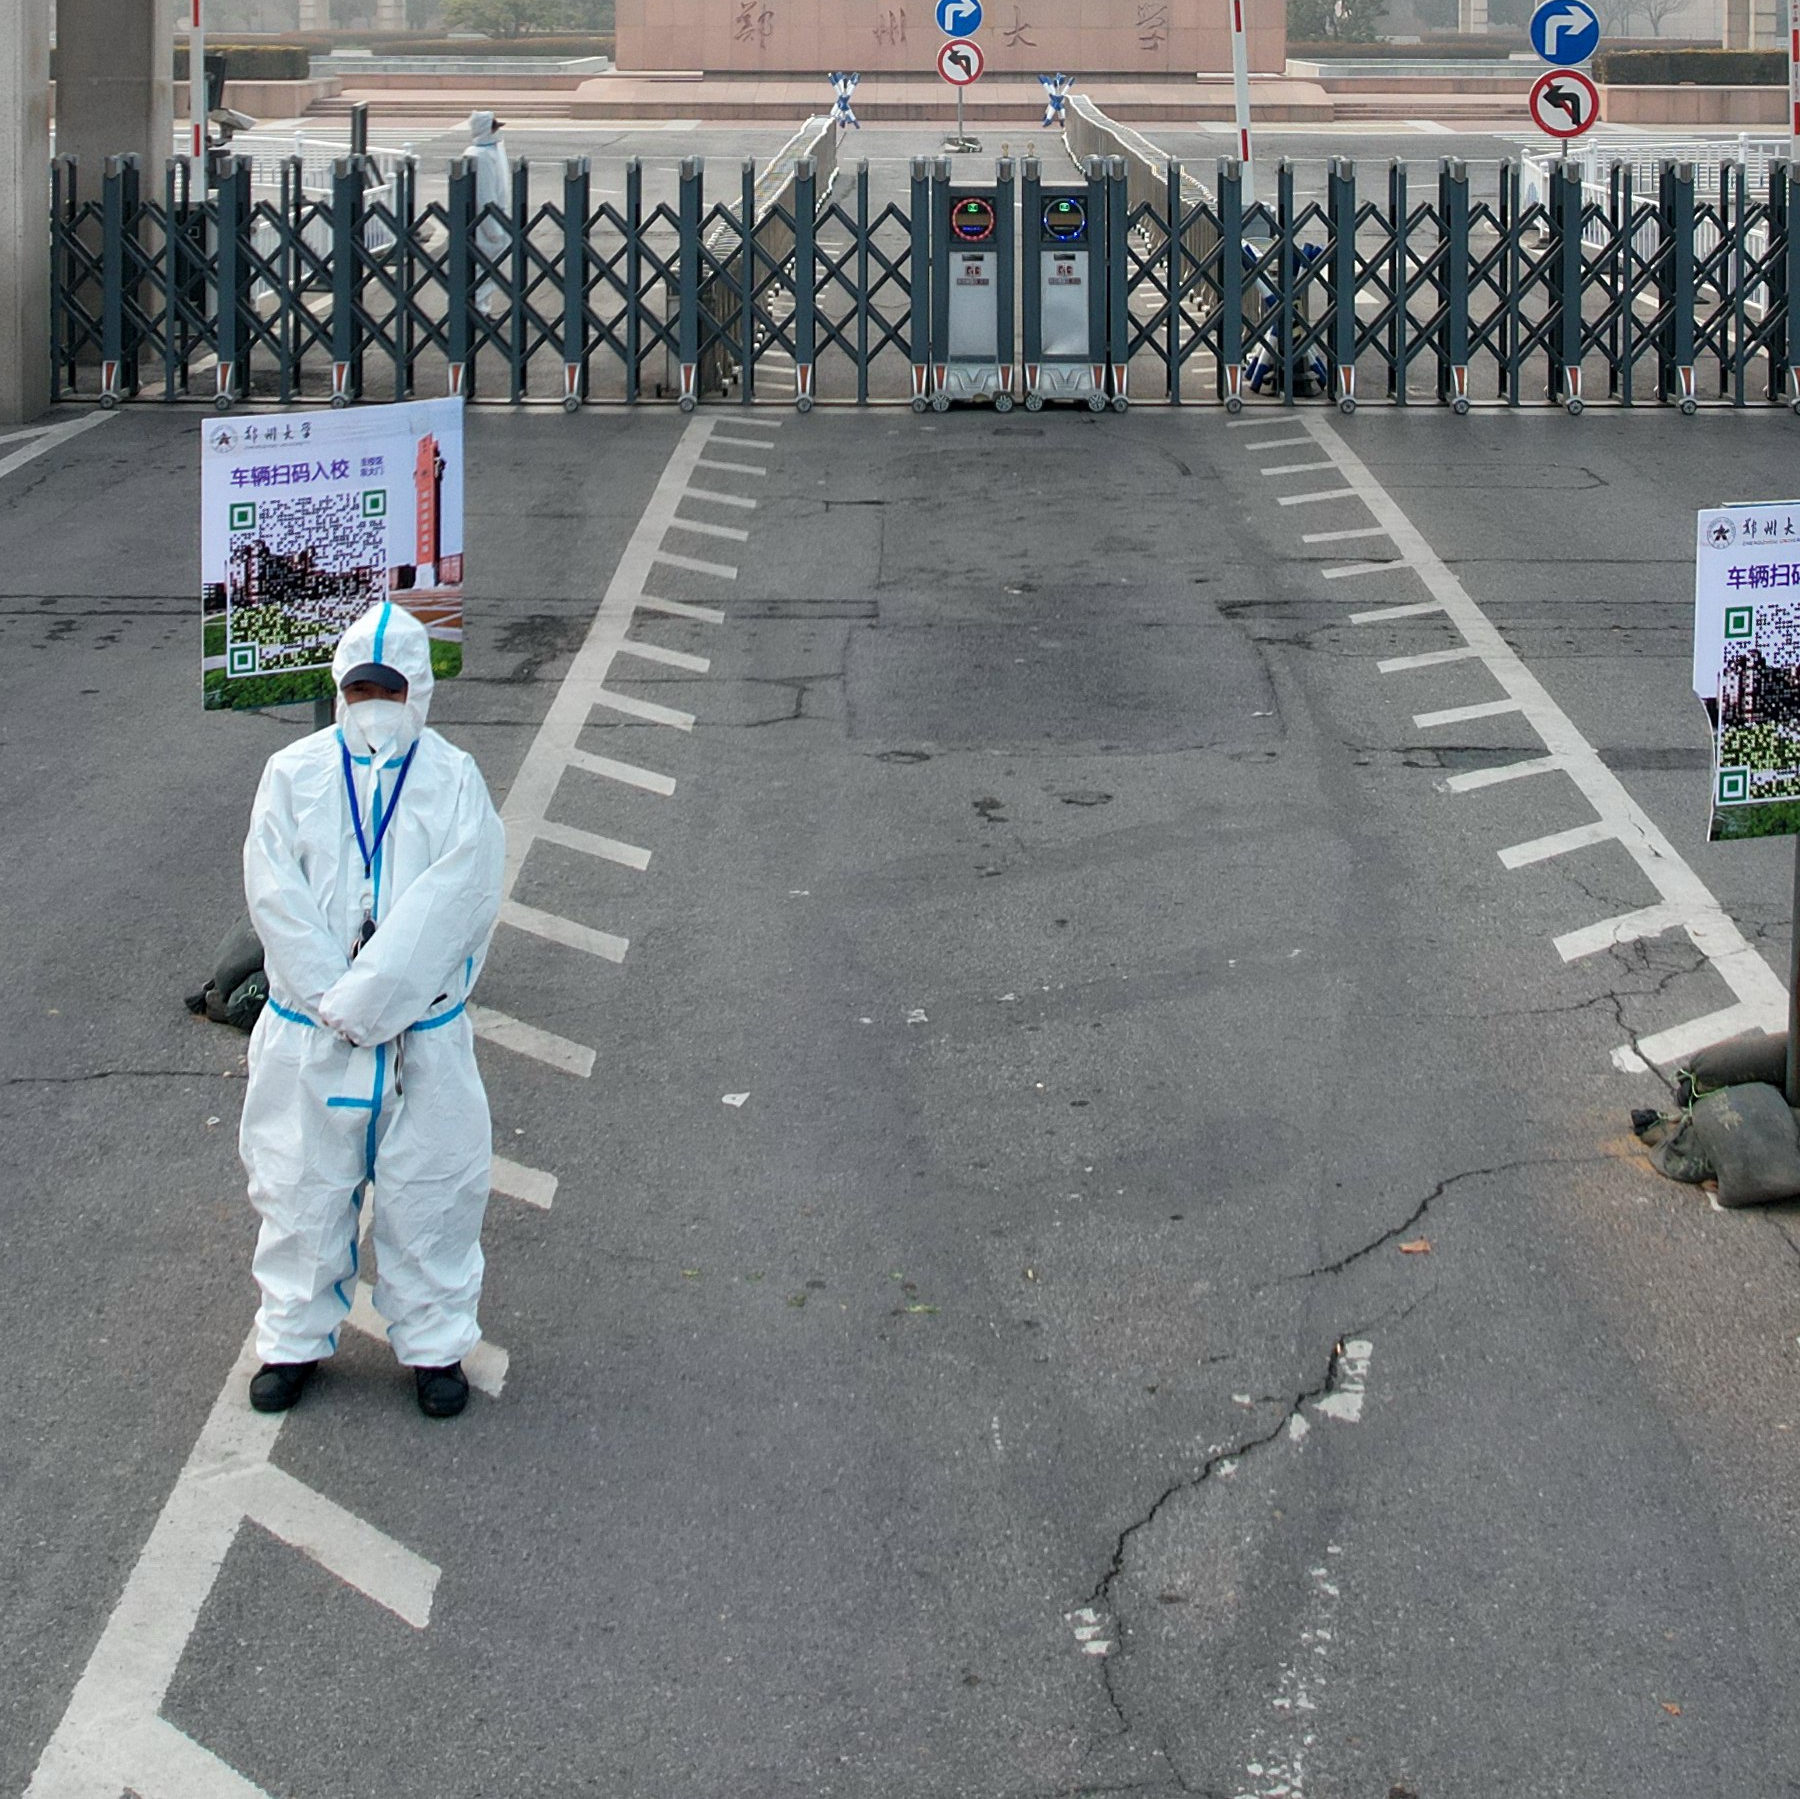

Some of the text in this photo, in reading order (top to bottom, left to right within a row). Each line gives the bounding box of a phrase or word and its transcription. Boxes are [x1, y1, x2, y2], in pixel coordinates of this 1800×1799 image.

[229, 457, 350, 489] 车辆扫码入校
